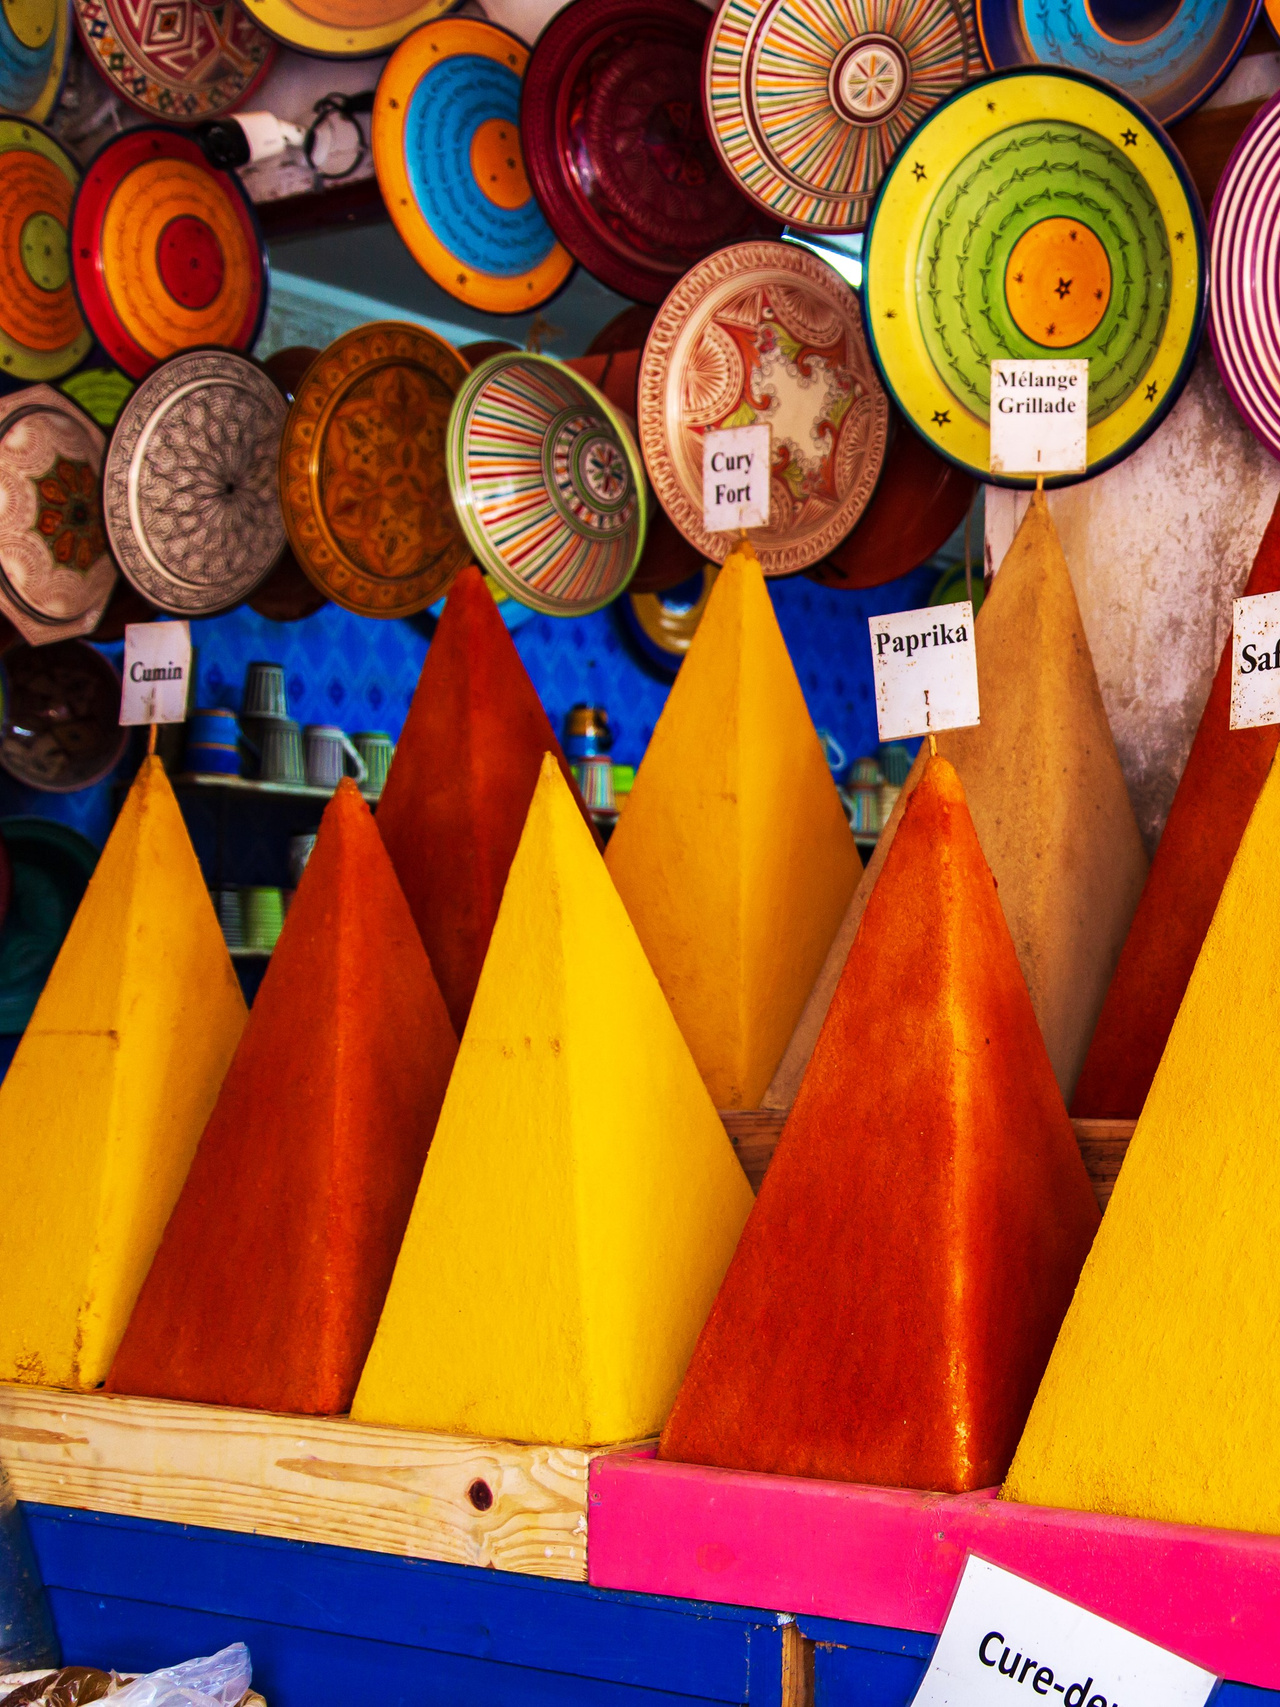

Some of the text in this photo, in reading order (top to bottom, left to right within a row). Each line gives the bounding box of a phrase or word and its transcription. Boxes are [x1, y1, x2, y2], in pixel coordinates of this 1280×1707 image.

[997, 371, 1078, 391] Mélange
[998, 397, 1076, 414] Grillade
[711, 451, 755, 475] Cury
[715, 482, 751, 505] Fort
[874, 624, 969, 658] Paprika
[130, 661, 182, 683] Cumin
[978, 1631, 1118, 1707] Cure-d
